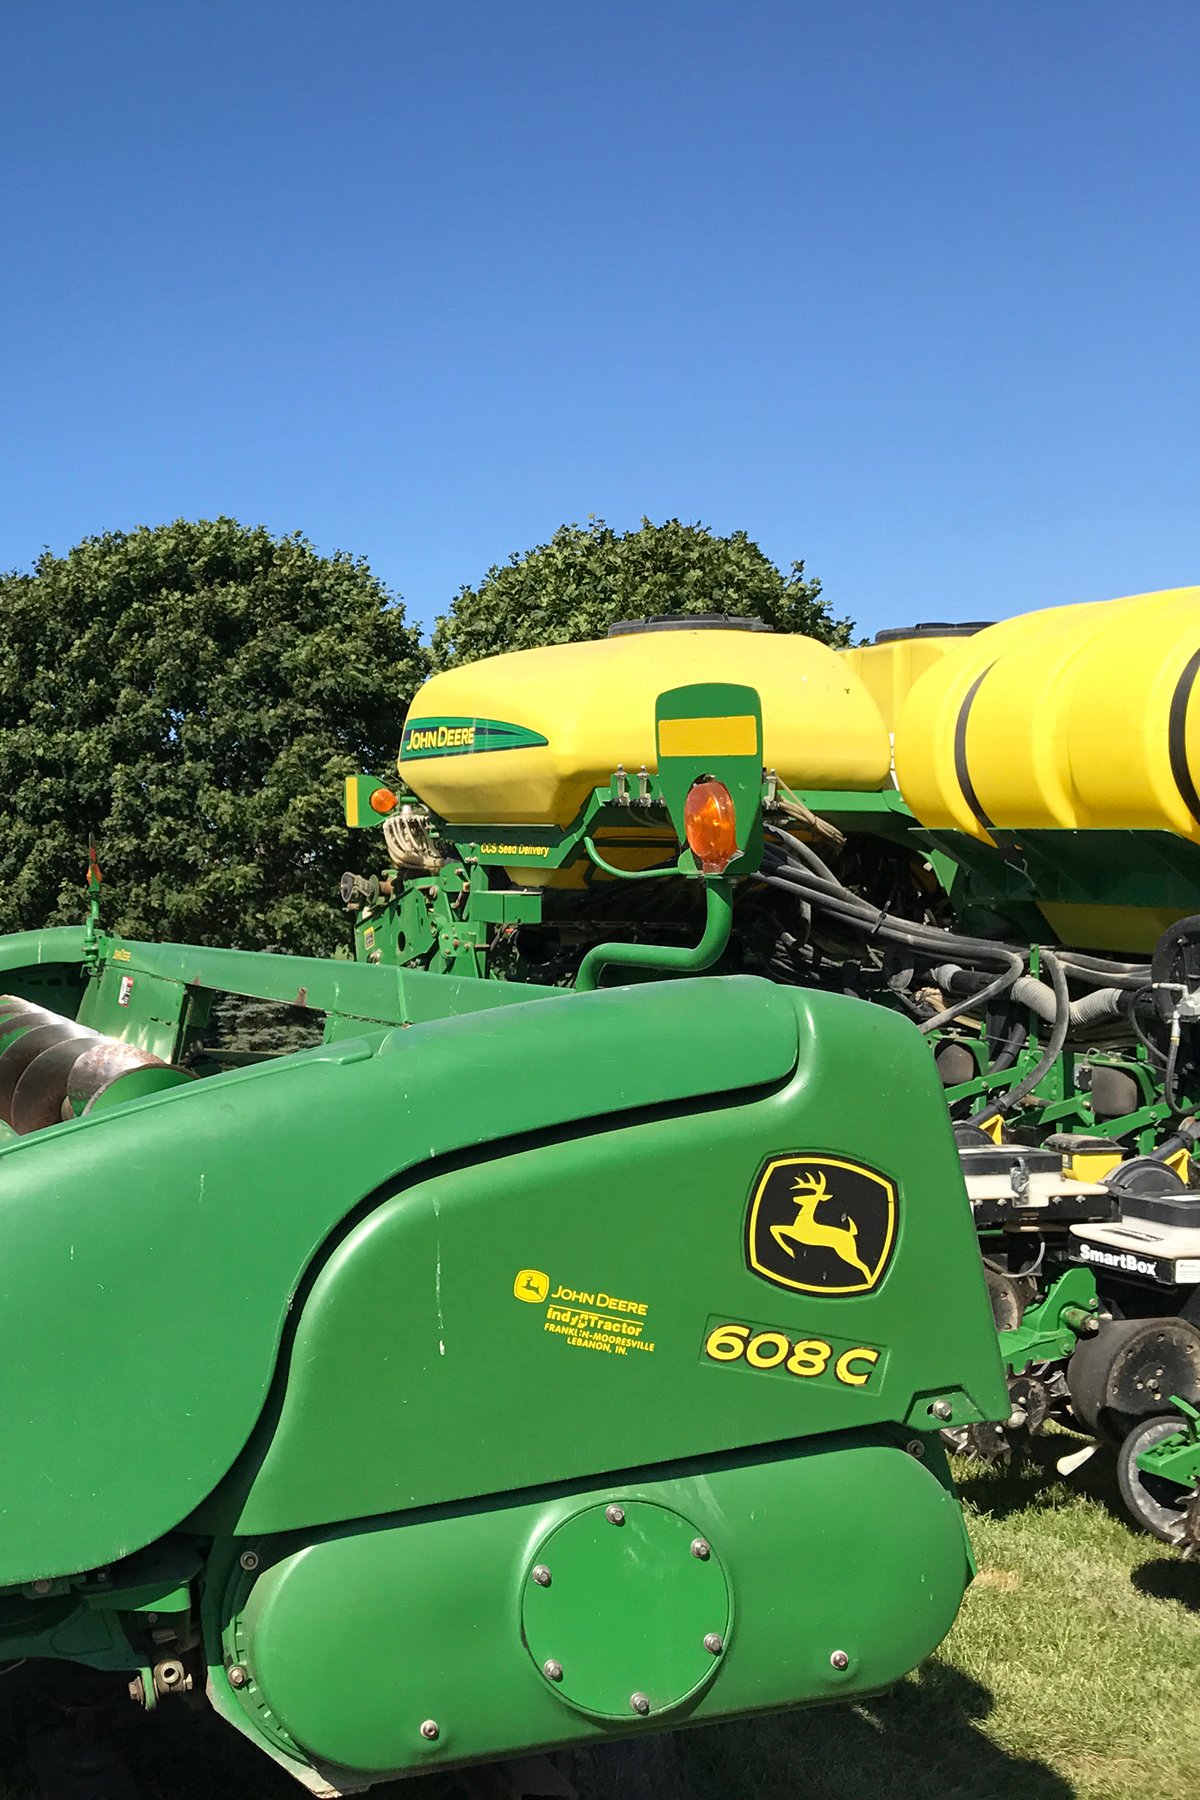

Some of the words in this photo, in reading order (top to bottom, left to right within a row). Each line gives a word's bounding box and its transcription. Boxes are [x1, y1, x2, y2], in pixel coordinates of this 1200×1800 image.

[406, 729, 437, 750] JOHN
[438, 726, 476, 747] DEERE
[481, 843, 497, 854] CCS
[498, 843, 517, 855] Seed
[518, 845, 550, 858] Delivery
[1080, 1243, 1157, 1276] SmartBox
[552, 1285, 595, 1305] JOHN
[596, 1293, 648, 1315] DEERE
[588, 1315, 643, 1337] Tractor
[614, 1345, 629, 1356] IN.
